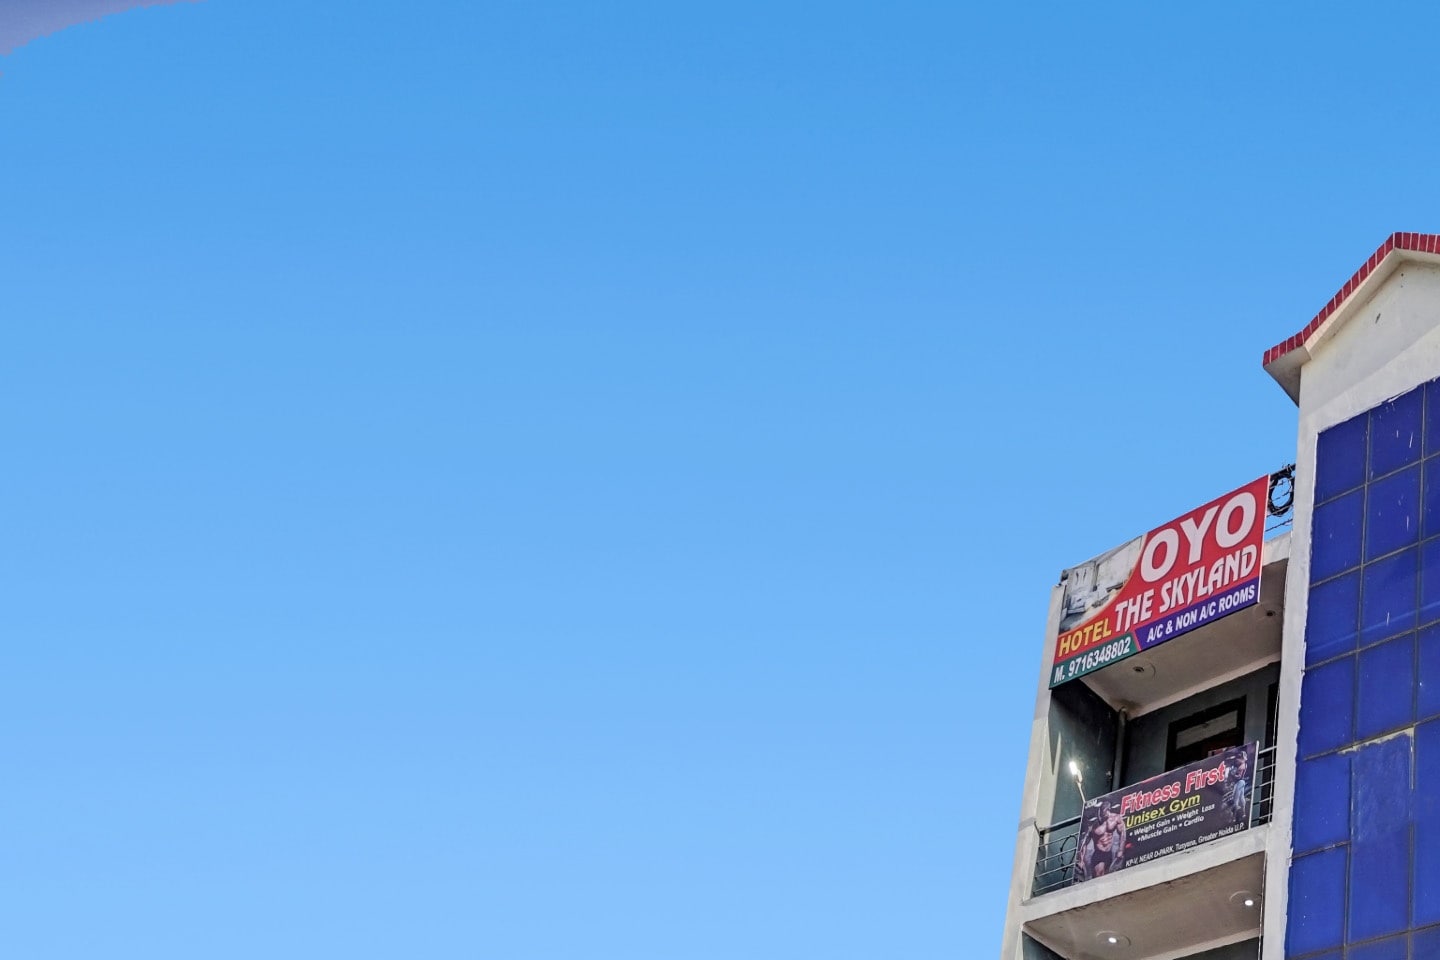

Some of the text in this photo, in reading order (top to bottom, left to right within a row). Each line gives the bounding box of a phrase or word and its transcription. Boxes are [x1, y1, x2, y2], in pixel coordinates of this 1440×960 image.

[1140, 492, 1257, 583] OYO
[1058, 544, 1257, 658] HOTEL THE SKYLAND
[1146, 585, 1255, 643] A/C & NON A/C ROOMS
[1053, 636, 1131, 683] M. 9716348802
[1120, 761, 1226, 817] Fitness First
[1126, 794, 1200, 829] Unisex Gym
[1134, 825, 1155, 836] Weight
[1156, 819, 1170, 828] Gain
[1176, 809, 1199, 821] Weight
[1140, 816, 1205, 842] Muscle Gain Cardio
